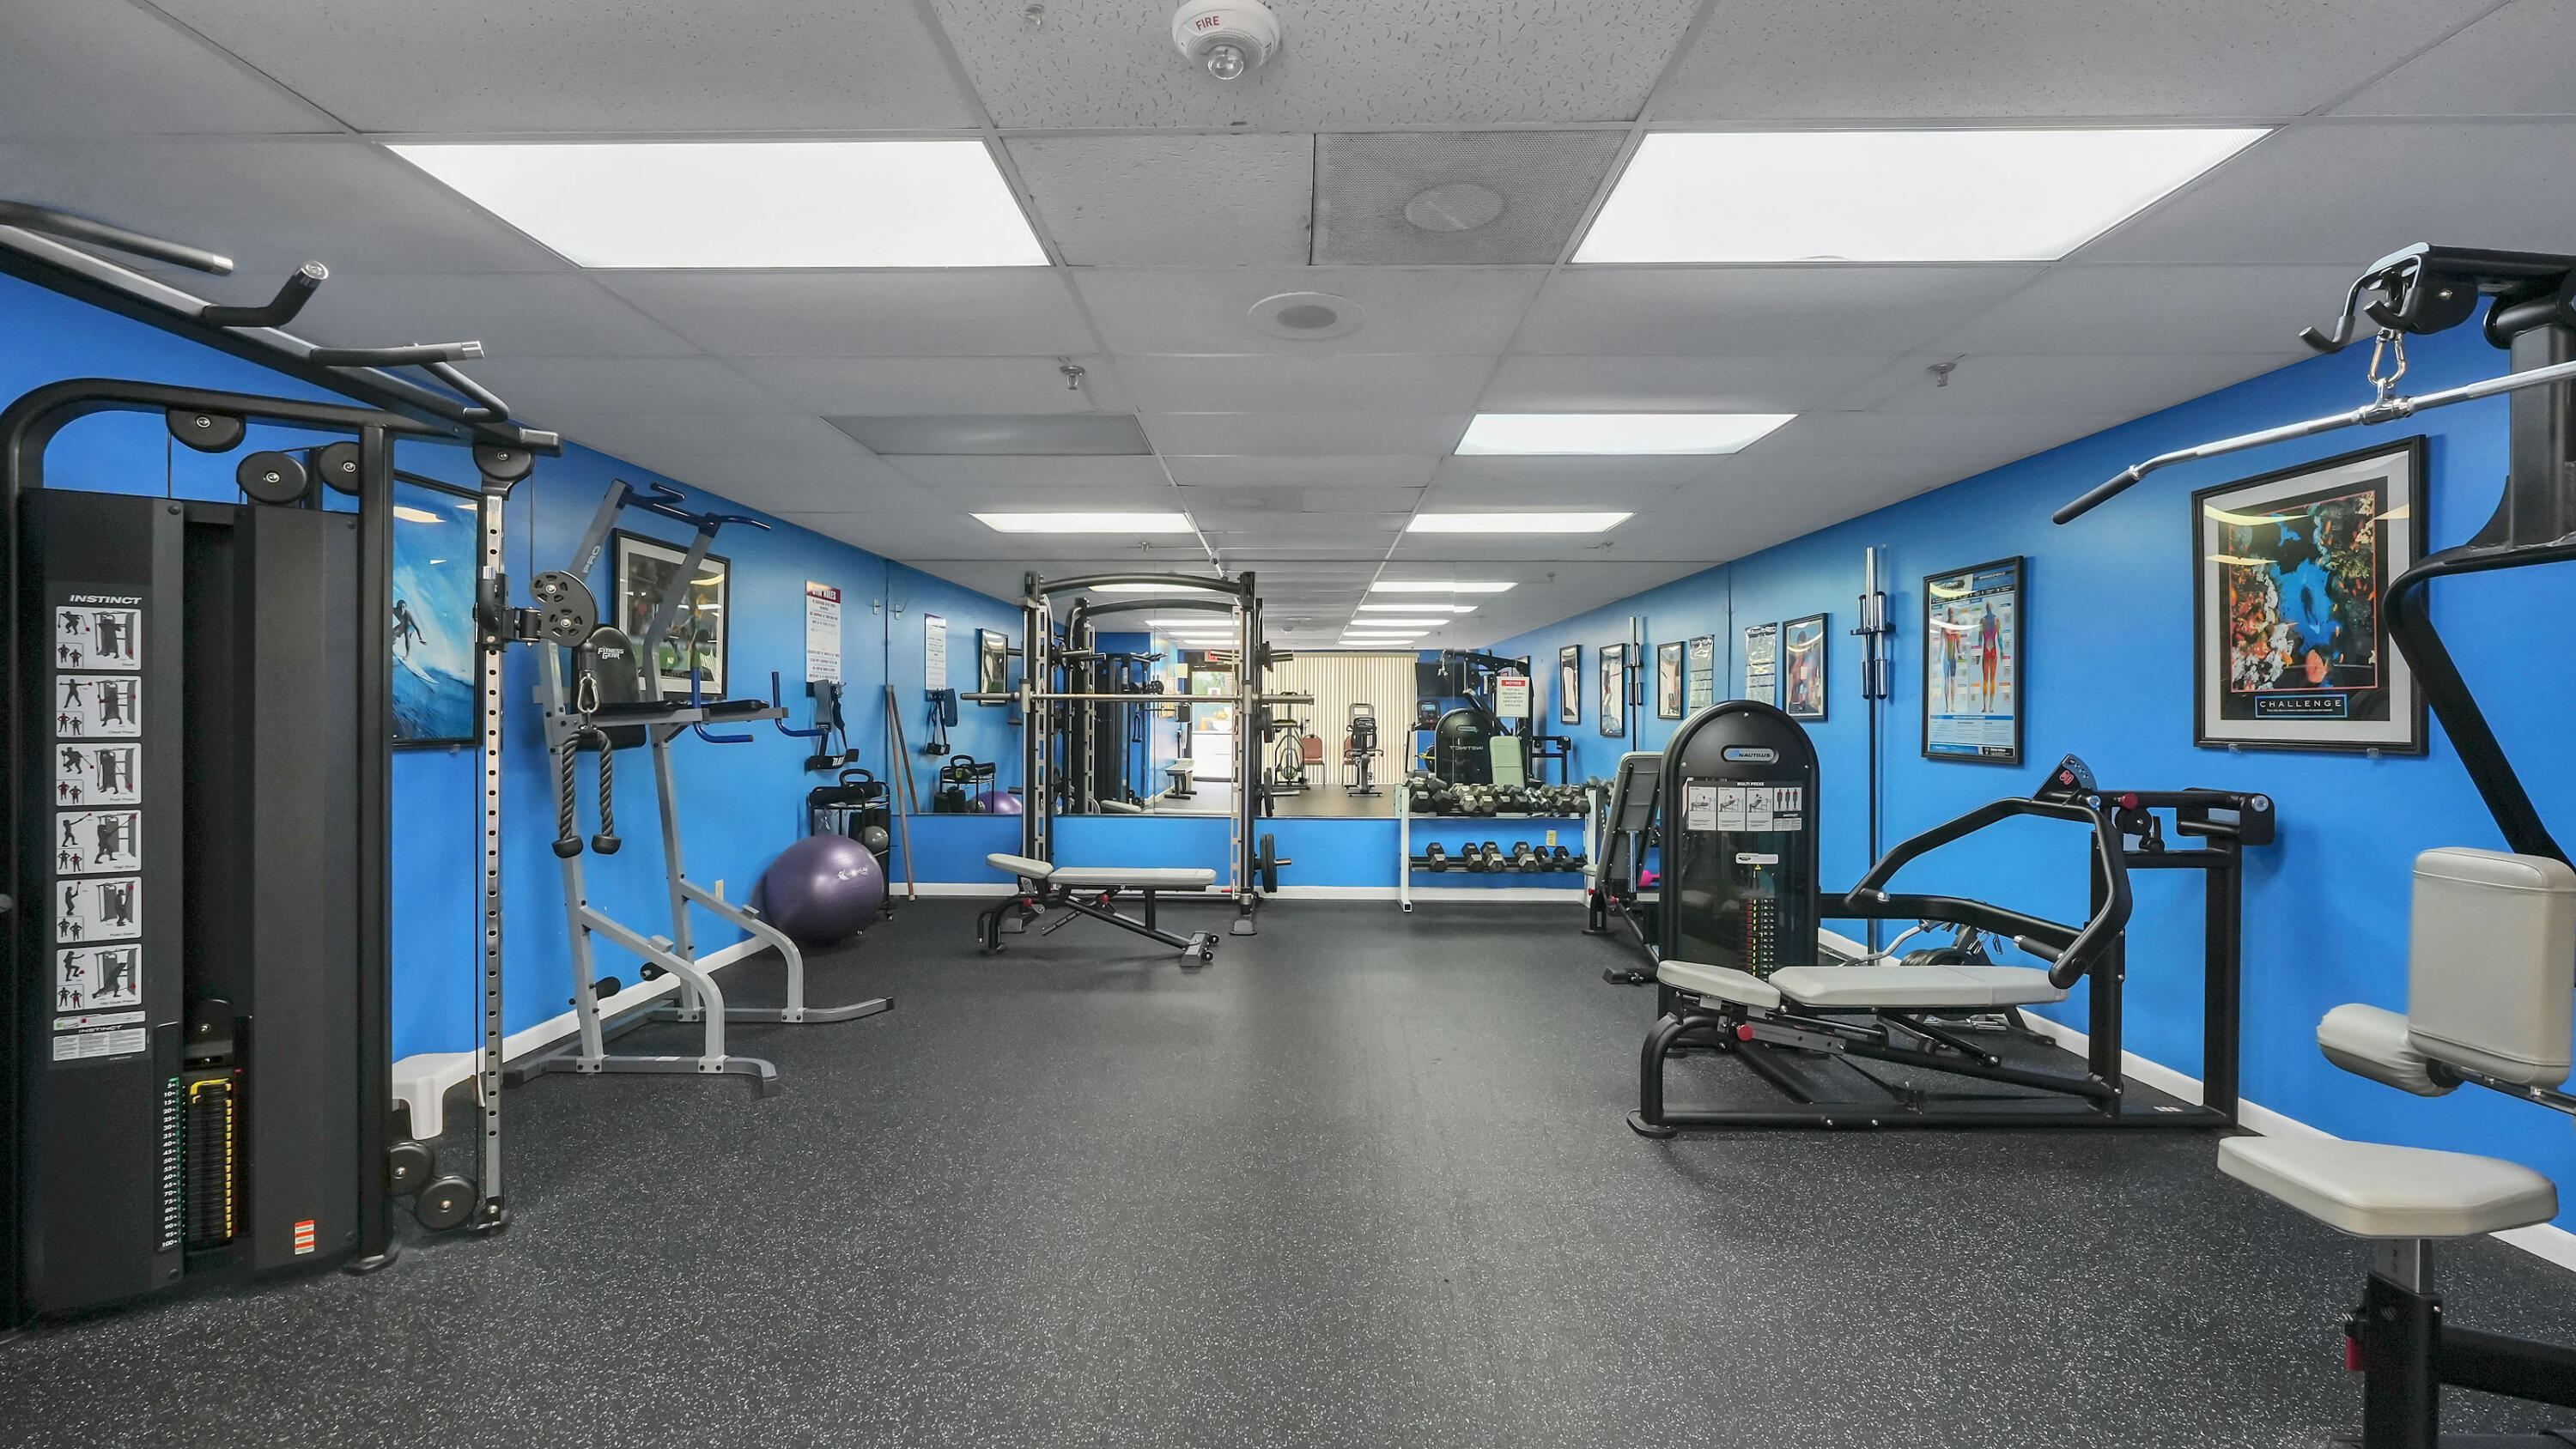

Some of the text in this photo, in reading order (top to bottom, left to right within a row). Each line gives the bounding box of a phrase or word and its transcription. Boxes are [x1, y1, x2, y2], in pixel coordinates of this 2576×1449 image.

[1195, 15, 1220, 31] FIRE
[583, 545, 601, 573] PRO
[70, 595, 143, 605] INSTINCT
